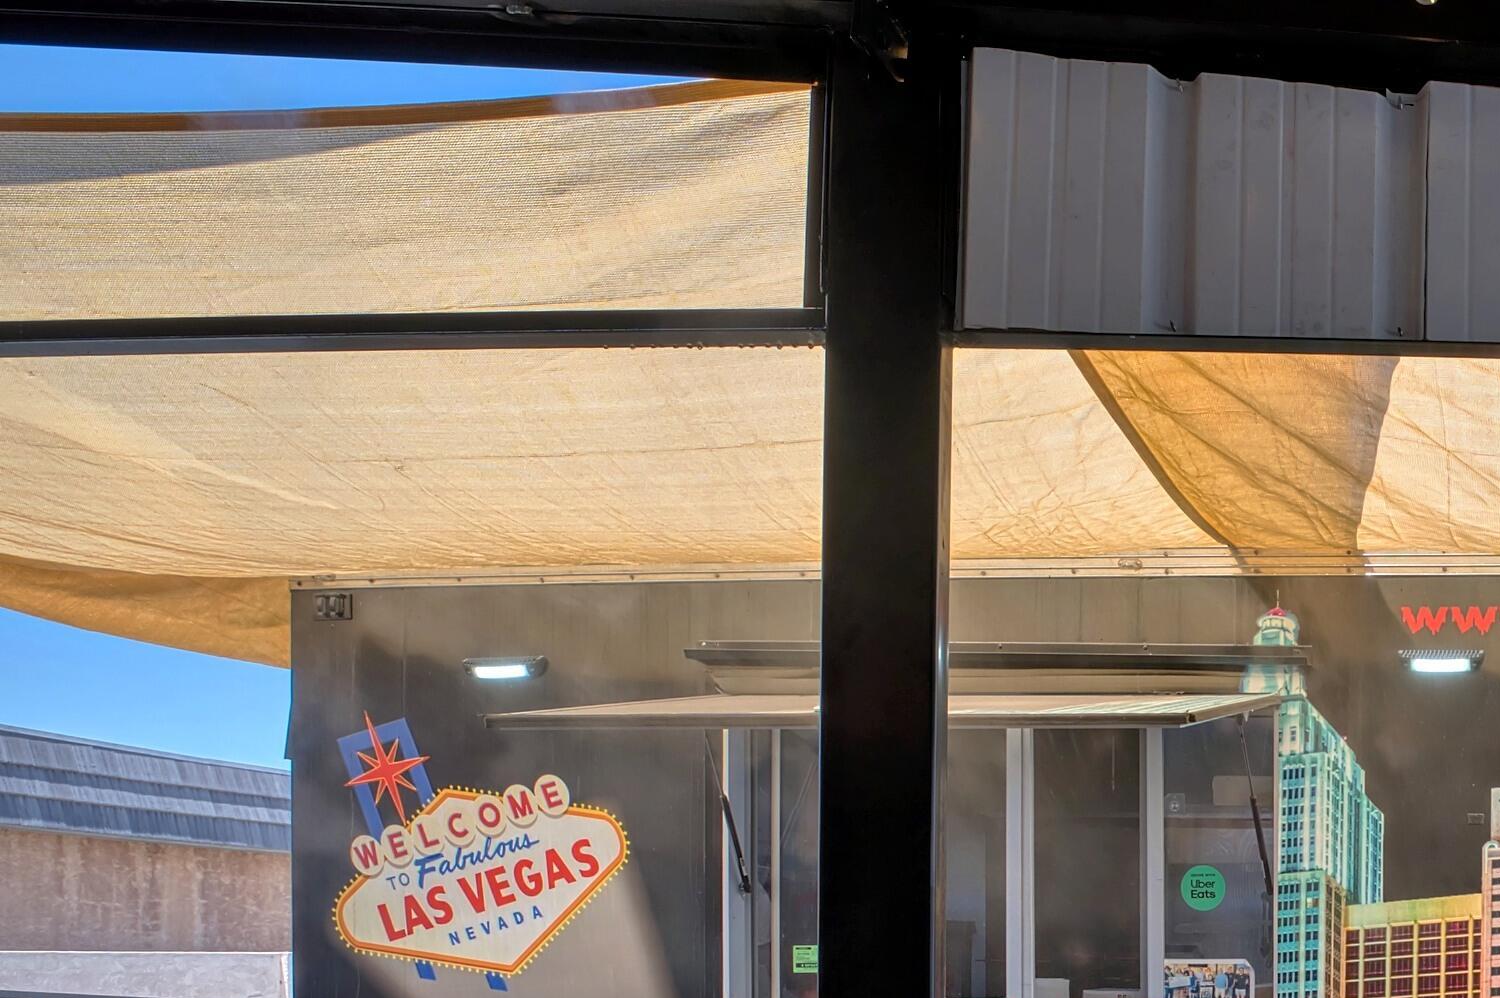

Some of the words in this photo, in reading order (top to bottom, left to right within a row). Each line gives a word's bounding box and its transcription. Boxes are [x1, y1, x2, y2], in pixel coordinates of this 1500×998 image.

[353, 780, 564, 869] WELCOME
[386, 872, 411, 890] TO
[414, 833, 540, 888] Fabulous
[1190, 879, 1216, 888] Uber
[377, 885, 454, 942] LAS
[457, 838, 600, 914] VEGAS
[1190, 889, 1216, 899] Eats
[449, 905, 544, 946] NEVADA
